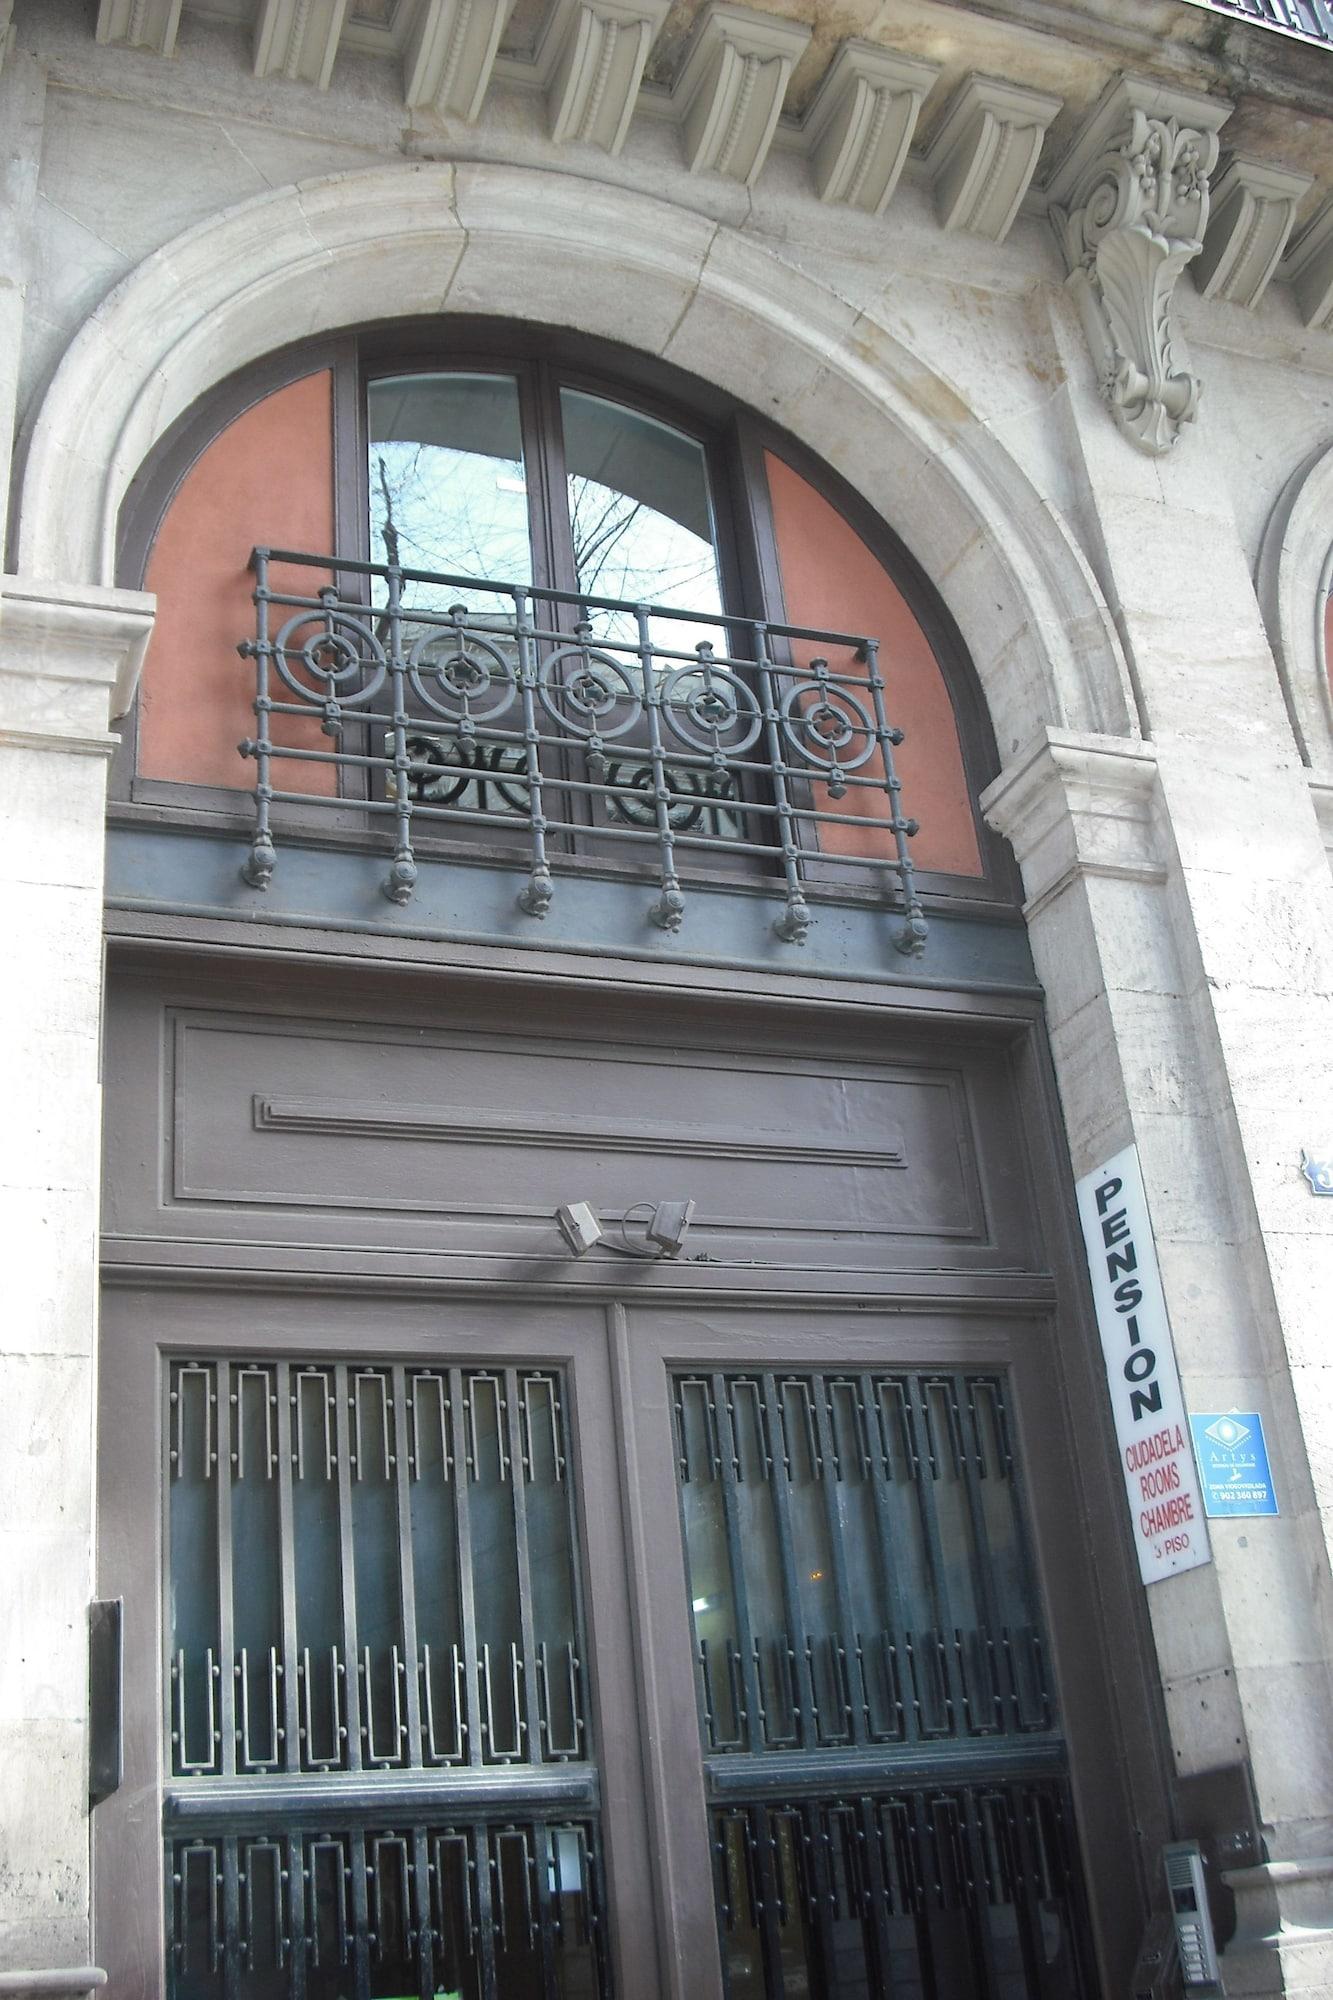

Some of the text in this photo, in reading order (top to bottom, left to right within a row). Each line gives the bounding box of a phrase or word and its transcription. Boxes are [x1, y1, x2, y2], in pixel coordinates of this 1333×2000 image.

[1095, 1177, 1162, 1422] PENSION
[1125, 1424, 1185, 1473] CIUDADELA
[1210, 1450, 1256, 1464] Artys
[1140, 1461, 1180, 1502] ROOMS
[1140, 1493, 1194, 1538] CHAMBRE
[1164, 1532, 1190, 1555] PISO
